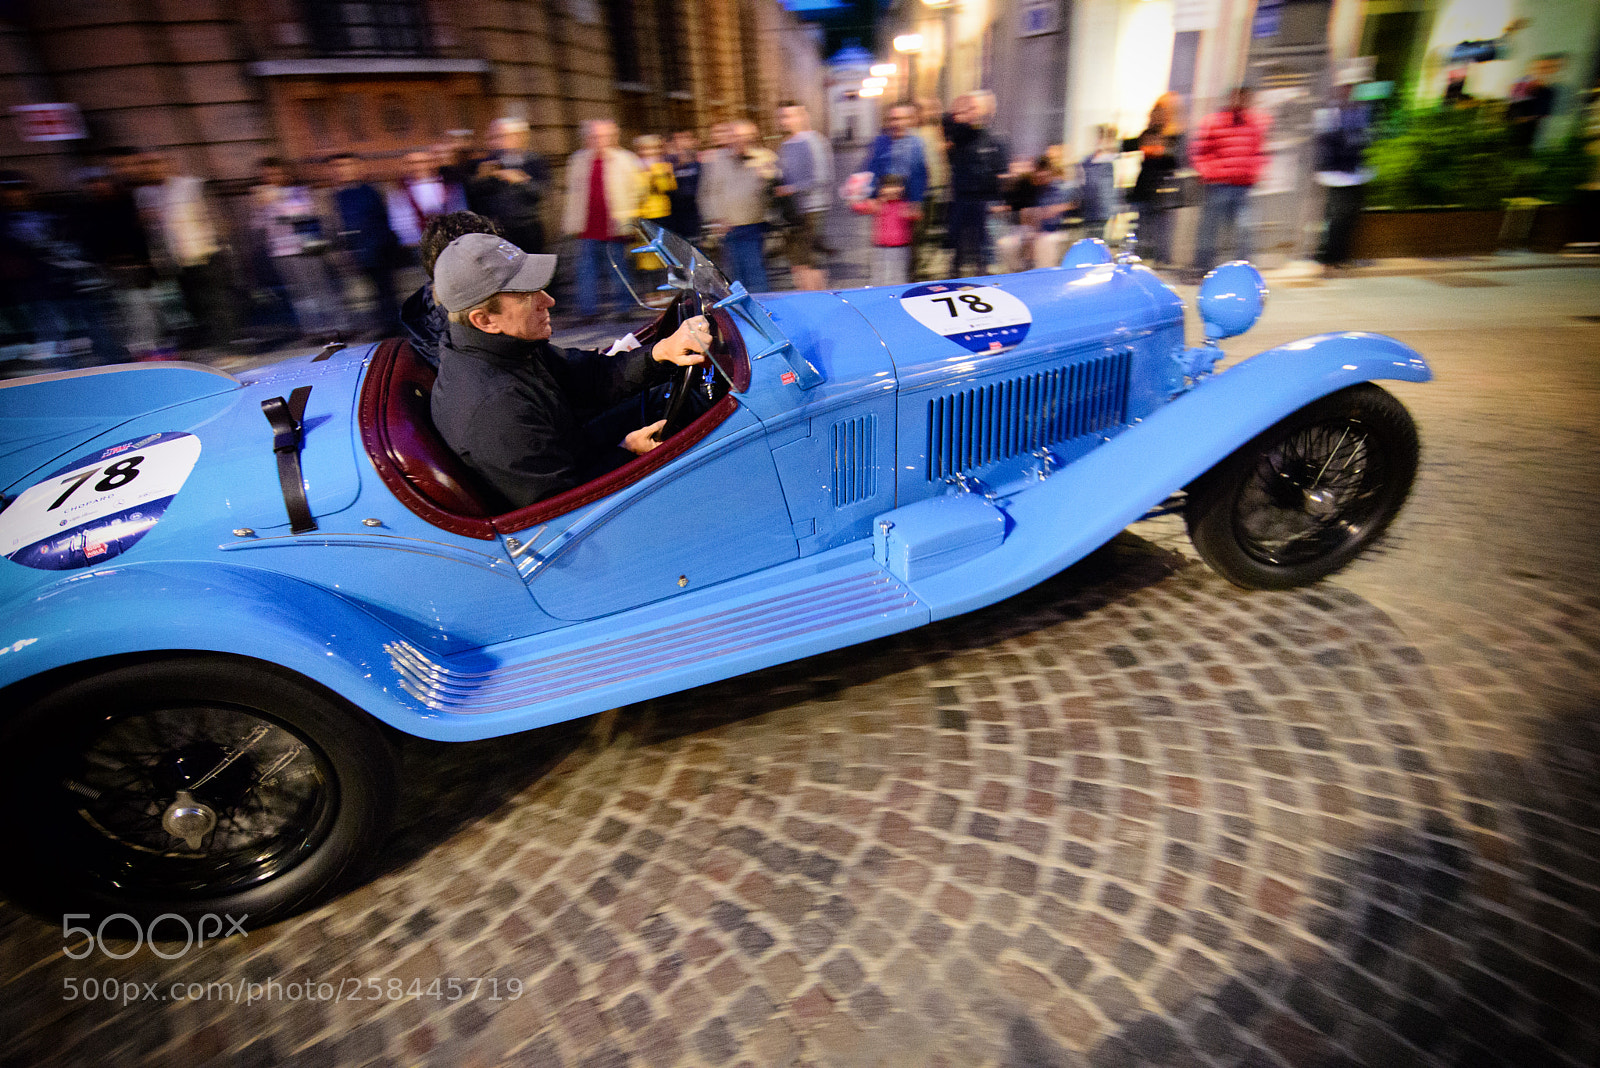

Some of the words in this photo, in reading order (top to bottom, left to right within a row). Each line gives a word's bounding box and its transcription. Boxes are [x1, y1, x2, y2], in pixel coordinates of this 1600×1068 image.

[931, 294, 993, 318] 78
[47, 455, 145, 512] 78
[63, 493, 115, 514] CHOPARD
